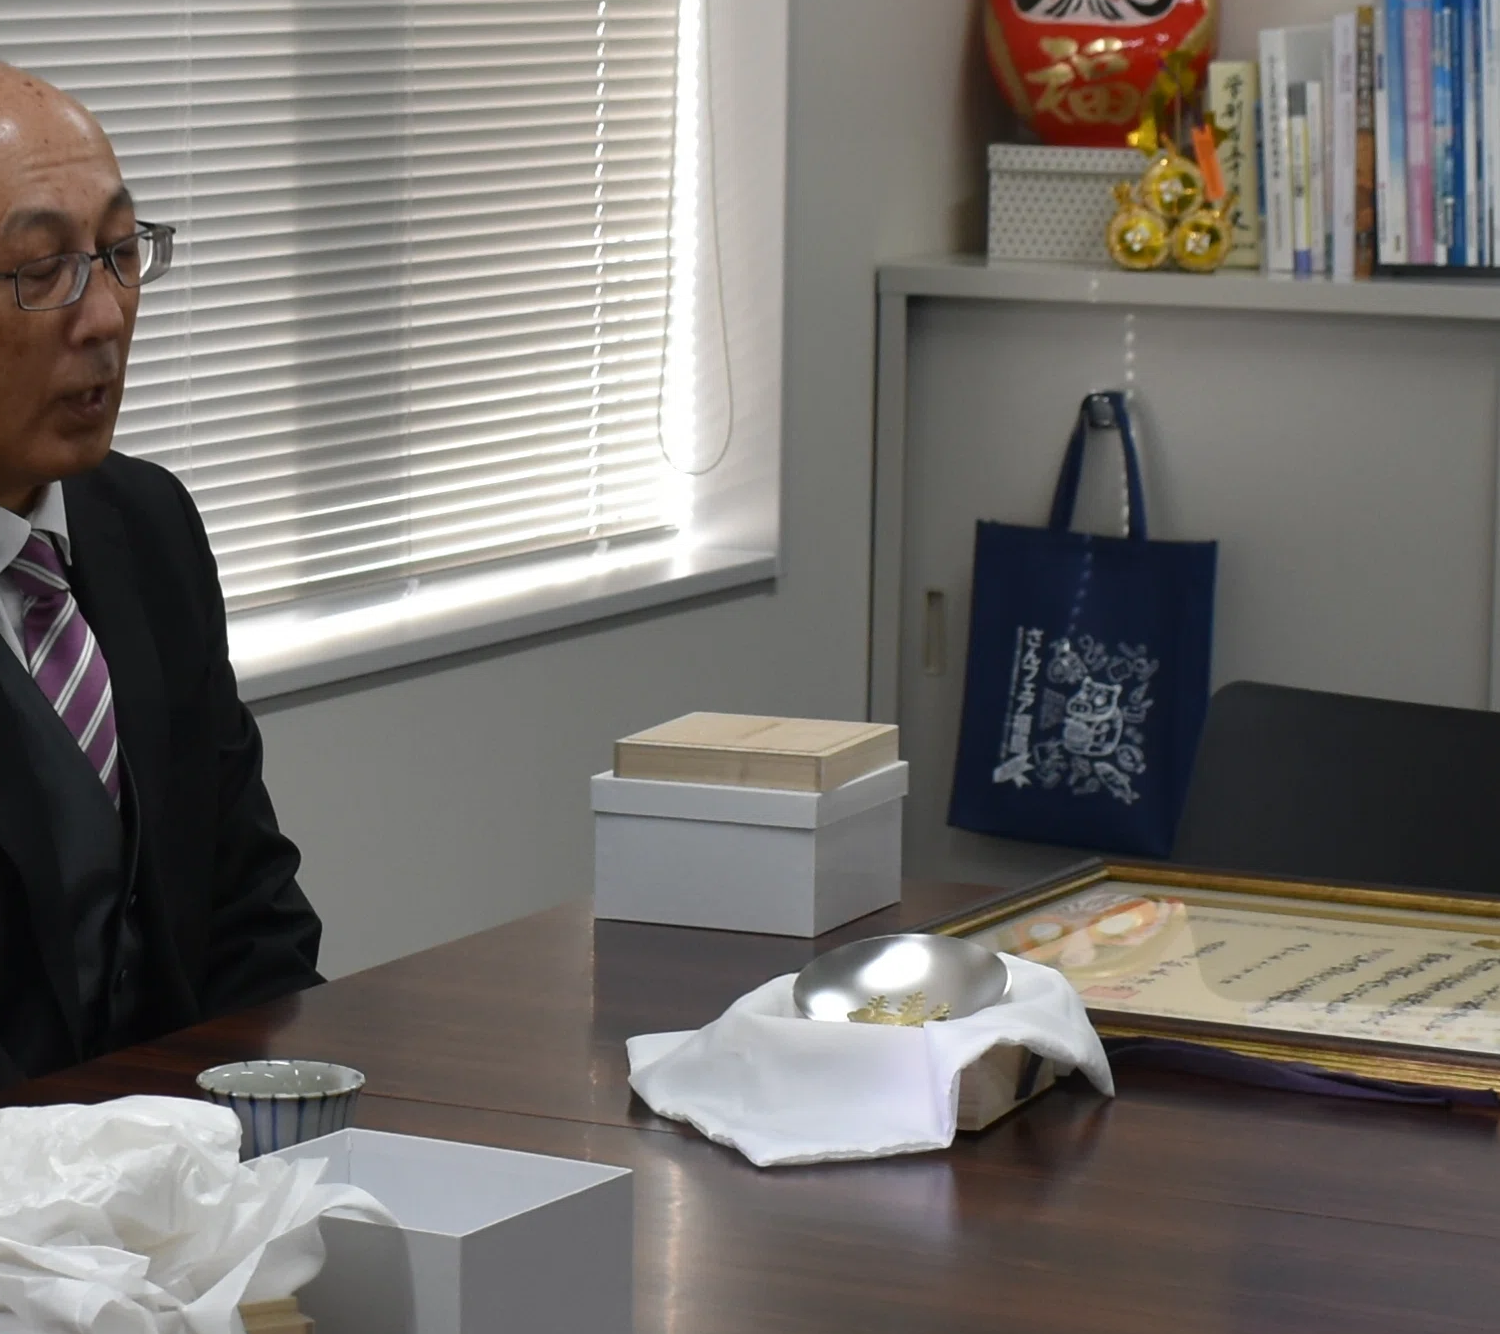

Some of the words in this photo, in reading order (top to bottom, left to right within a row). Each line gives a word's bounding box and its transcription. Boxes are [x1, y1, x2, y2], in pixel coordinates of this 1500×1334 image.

[1010, 627, 1045, 755] さんフェア
